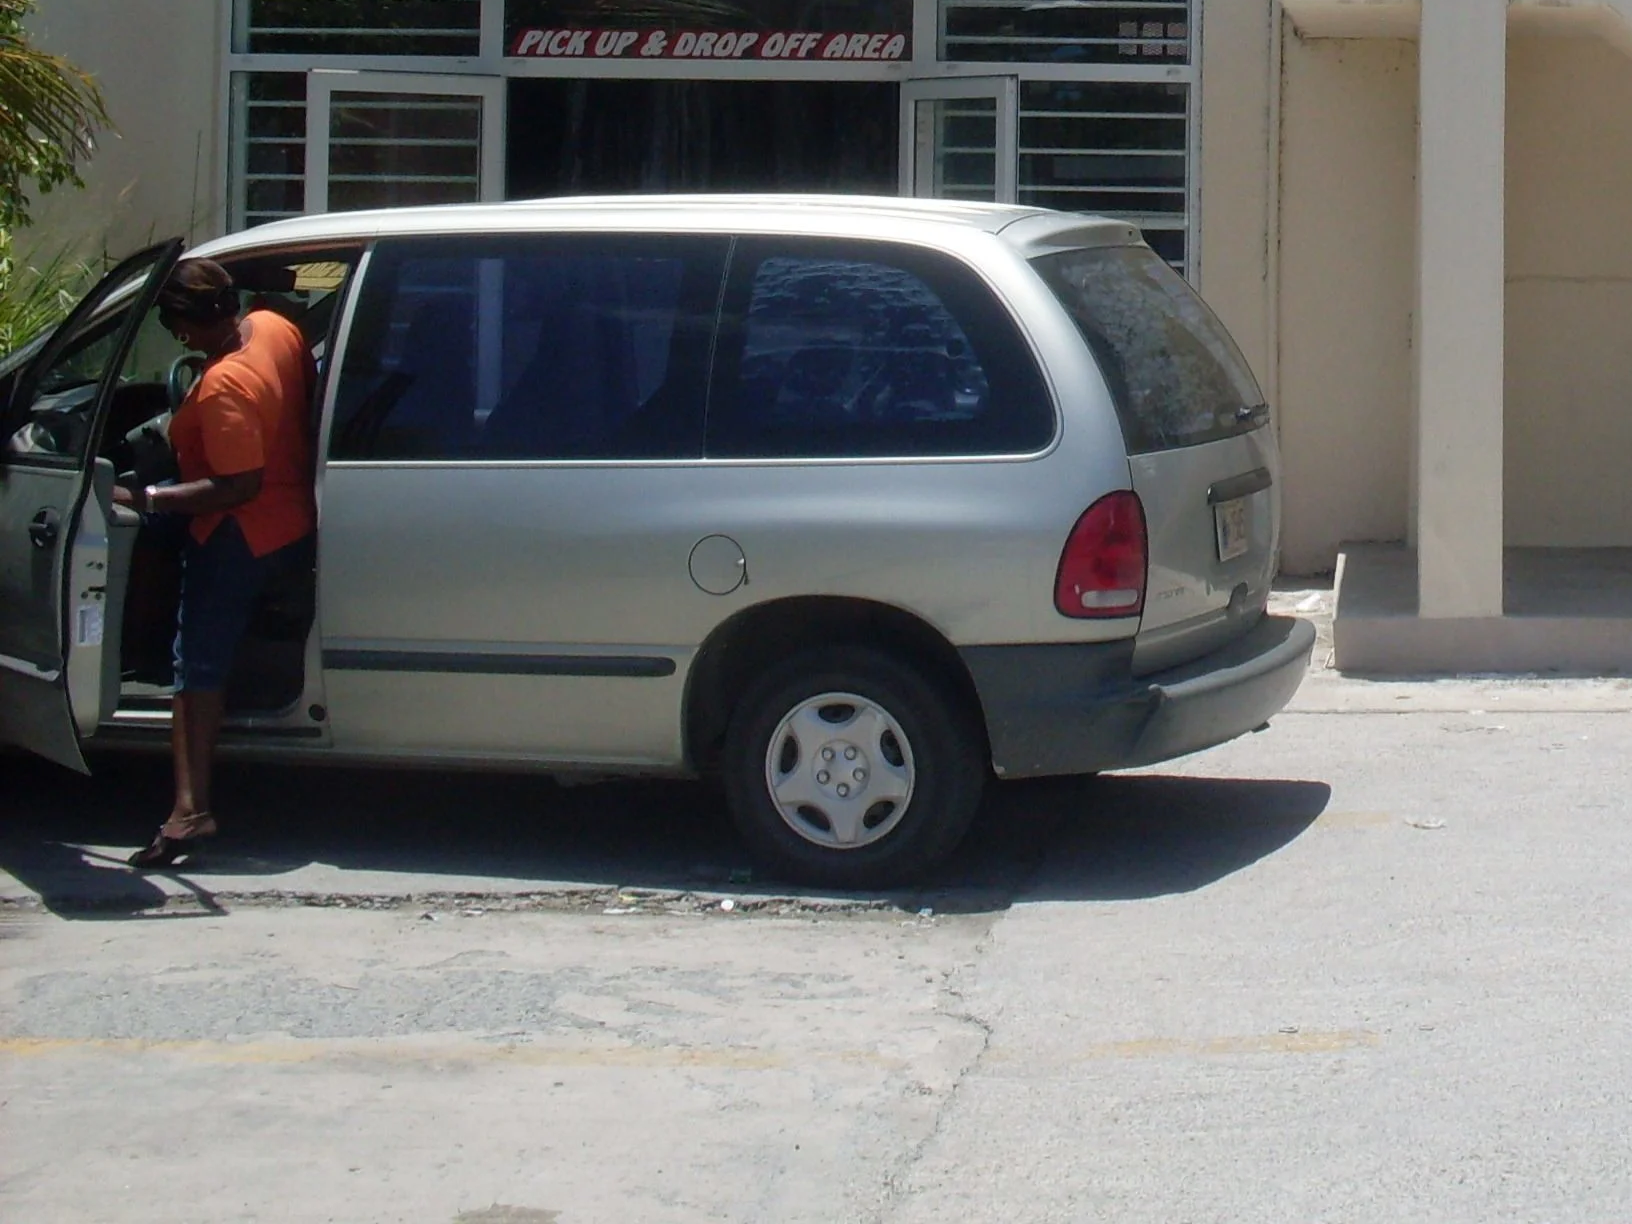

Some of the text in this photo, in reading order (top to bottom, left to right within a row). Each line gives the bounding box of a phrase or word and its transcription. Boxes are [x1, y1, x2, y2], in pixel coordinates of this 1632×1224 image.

[517, 30, 906, 59] PICK UP & DROP OFF AREA
